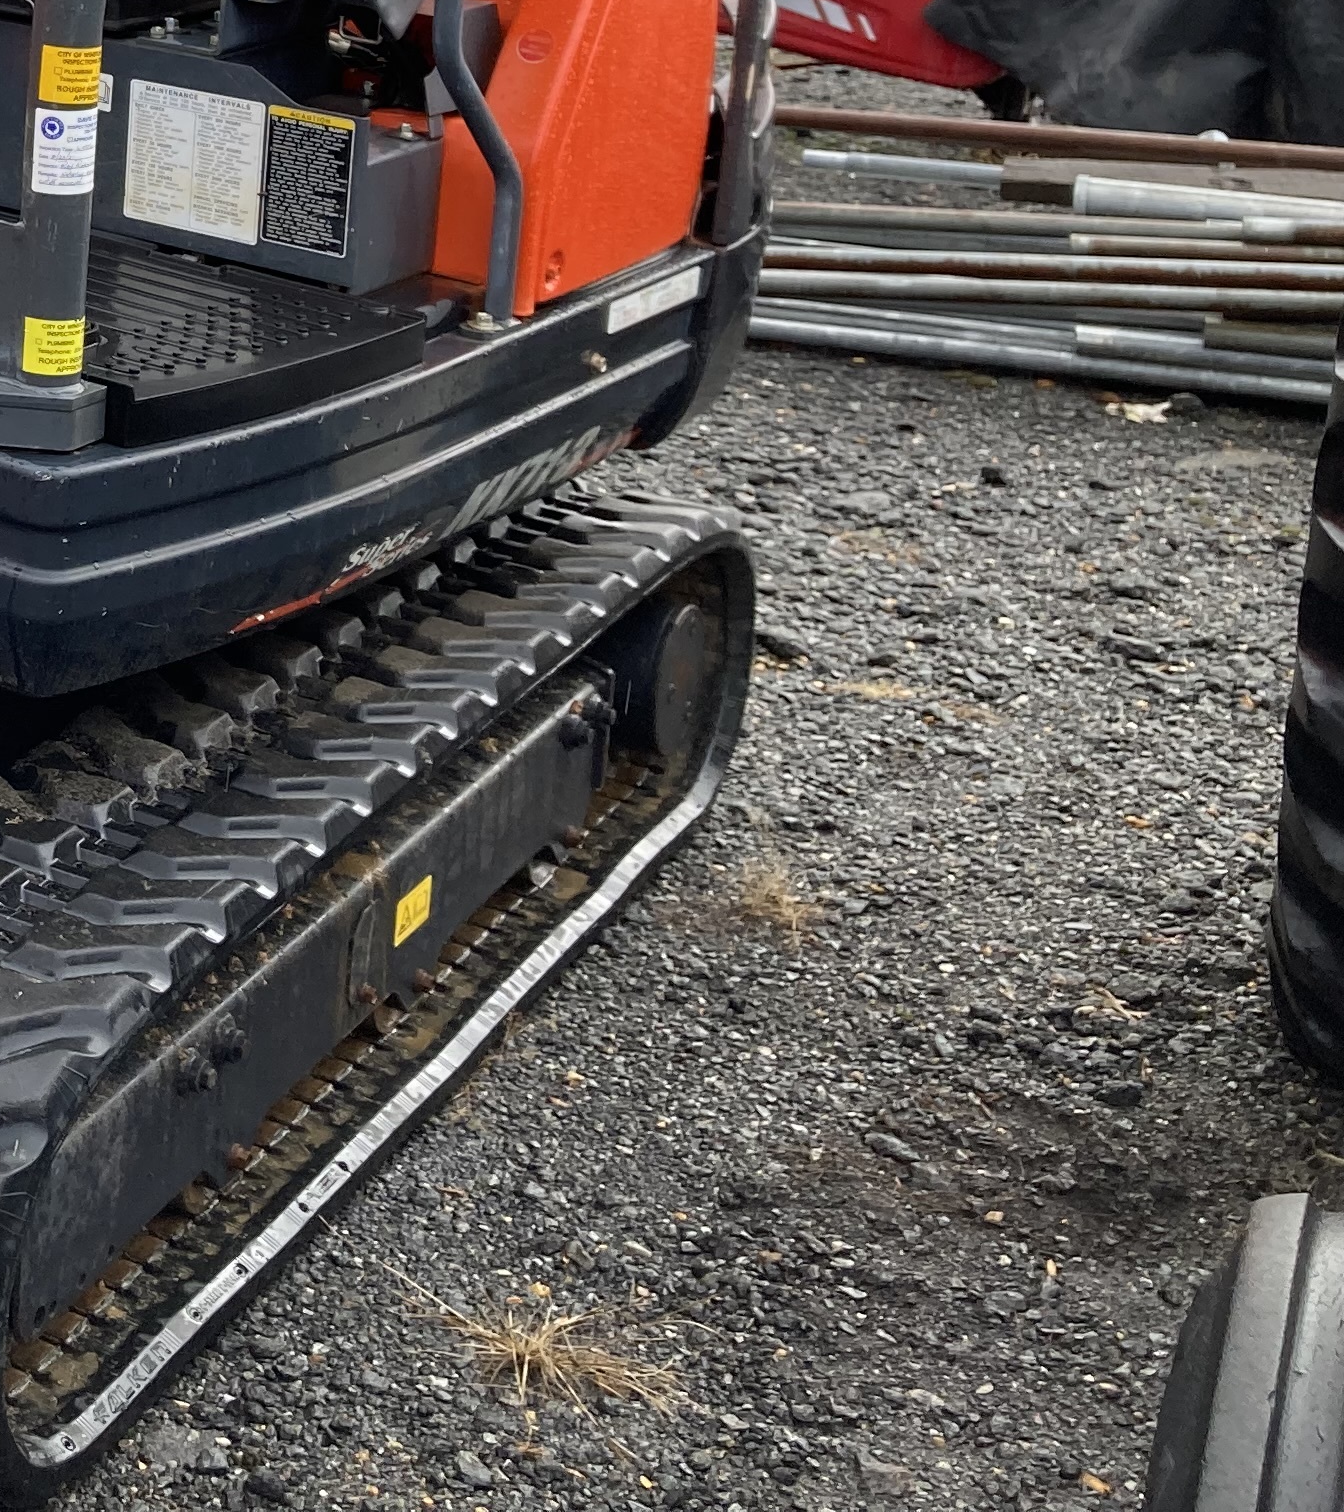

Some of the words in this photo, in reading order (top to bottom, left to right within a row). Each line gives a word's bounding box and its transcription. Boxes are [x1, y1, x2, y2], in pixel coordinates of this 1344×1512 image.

[146, 86, 198, 100] MAINTENANCE
[208, 98, 251, 110] INTERVALS
[342, 521, 421, 572] Super
